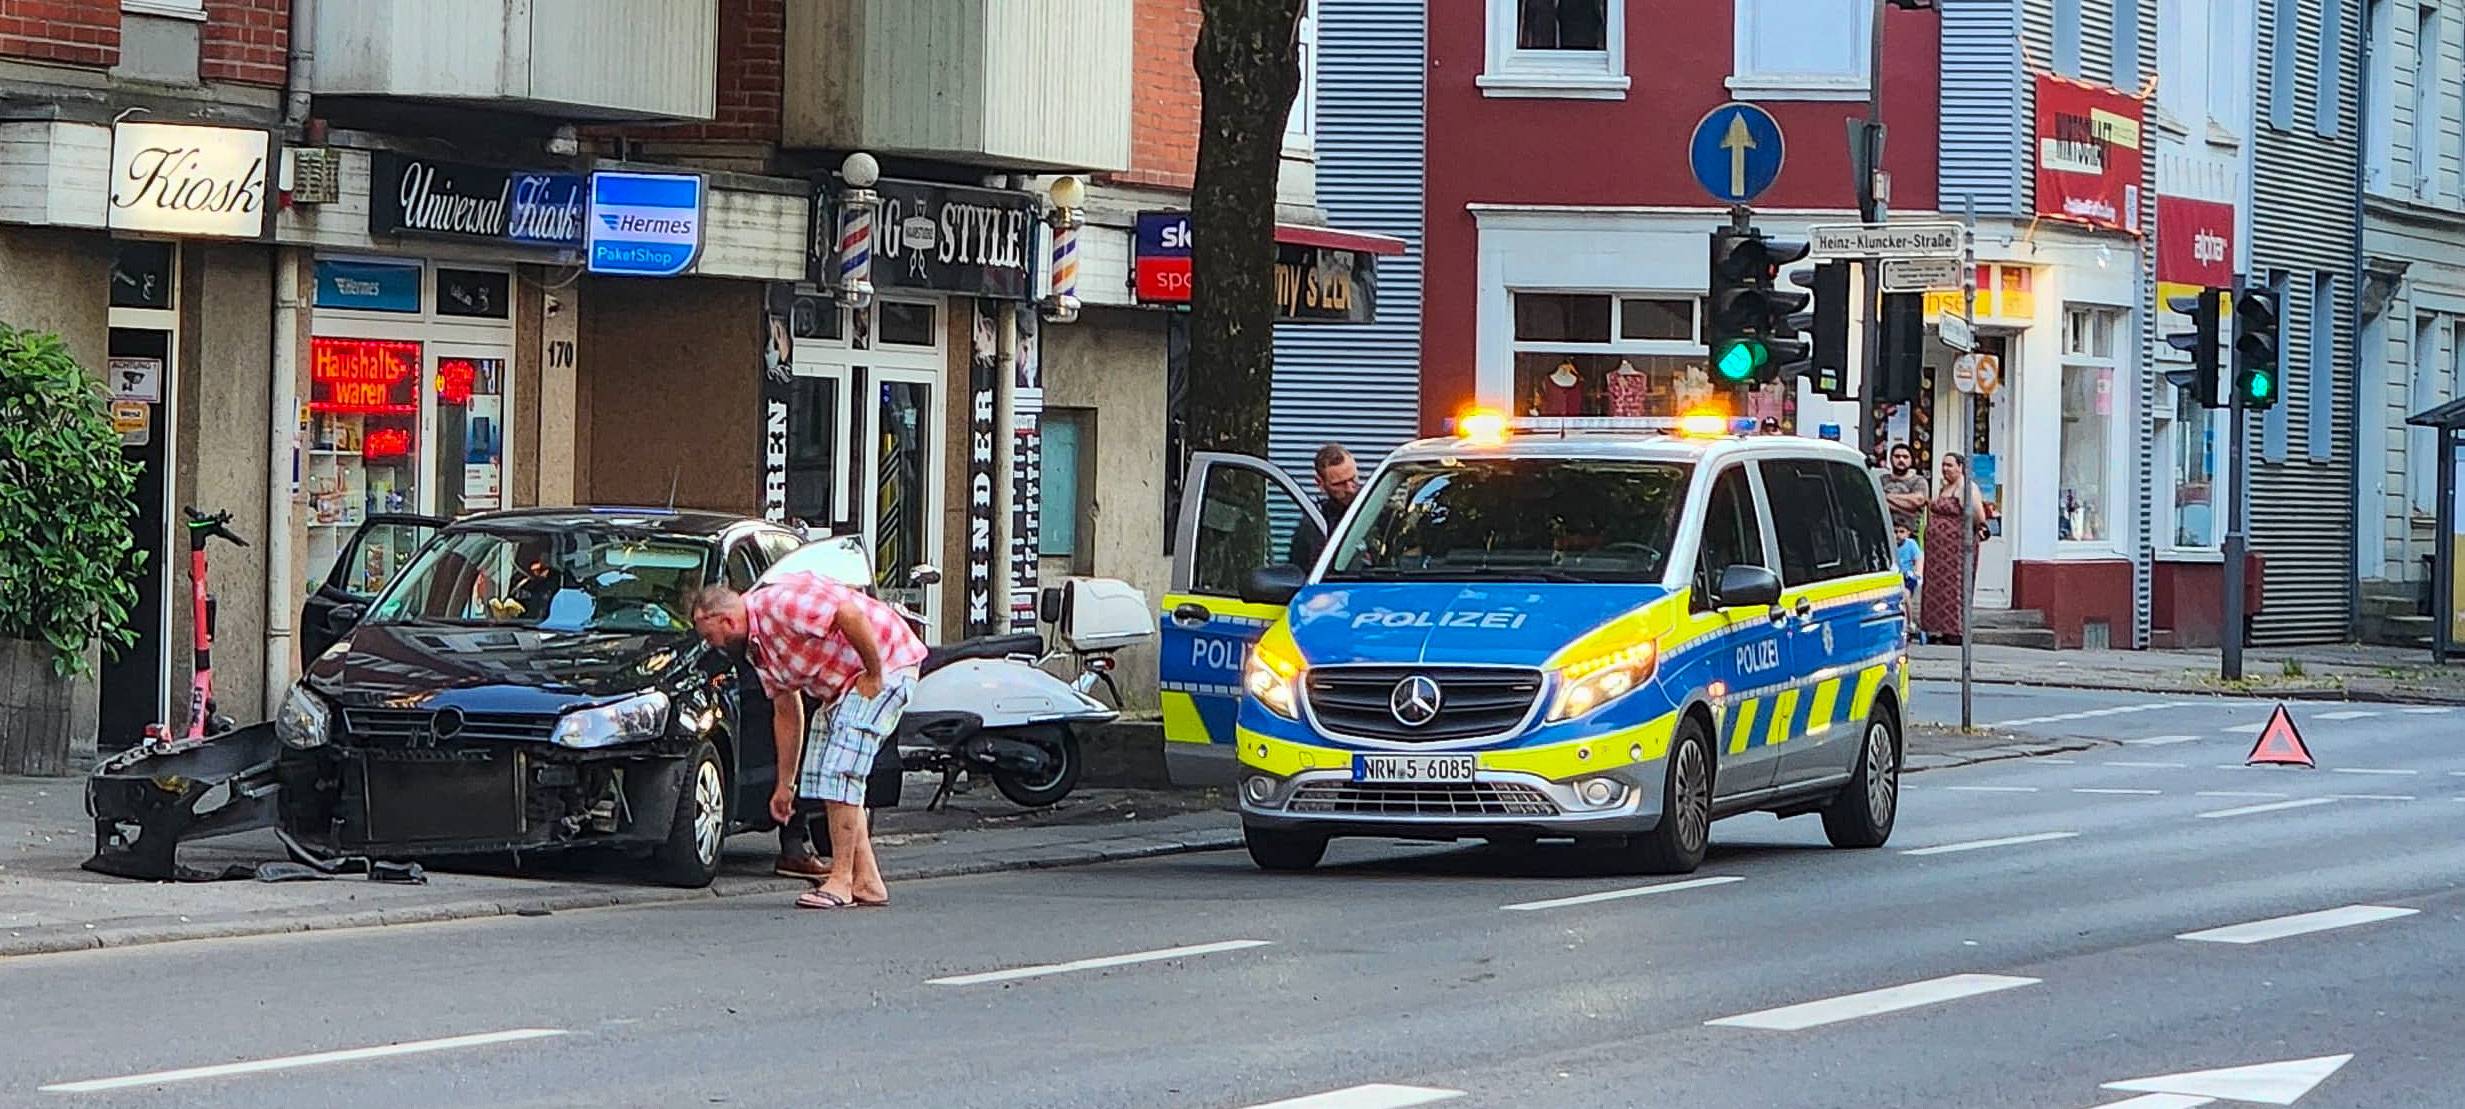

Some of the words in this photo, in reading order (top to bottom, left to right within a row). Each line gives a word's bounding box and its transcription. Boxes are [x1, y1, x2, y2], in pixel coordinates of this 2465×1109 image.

[112, 147, 263, 212] Kiosk
[401, 162, 511, 236] Universal
[509, 175, 579, 241] Kiosk
[619, 214, 692, 235] Hermes
[938, 202, 1024, 268] STYLE
[597, 246, 673, 265] PaketShop
[1819, 233, 1953, 250] Heinz-Kluncker-Straße
[317, 347, 408, 380] Haushalts-
[548, 339, 574, 369] 170
[336, 382, 387, 405] waren
[970, 388, 994, 626] KINDER
[1351, 611, 1528, 629] POLIZEI
[1735, 638, 1780, 678] POLIZEI
[1364, 759, 1397, 779] NRW
